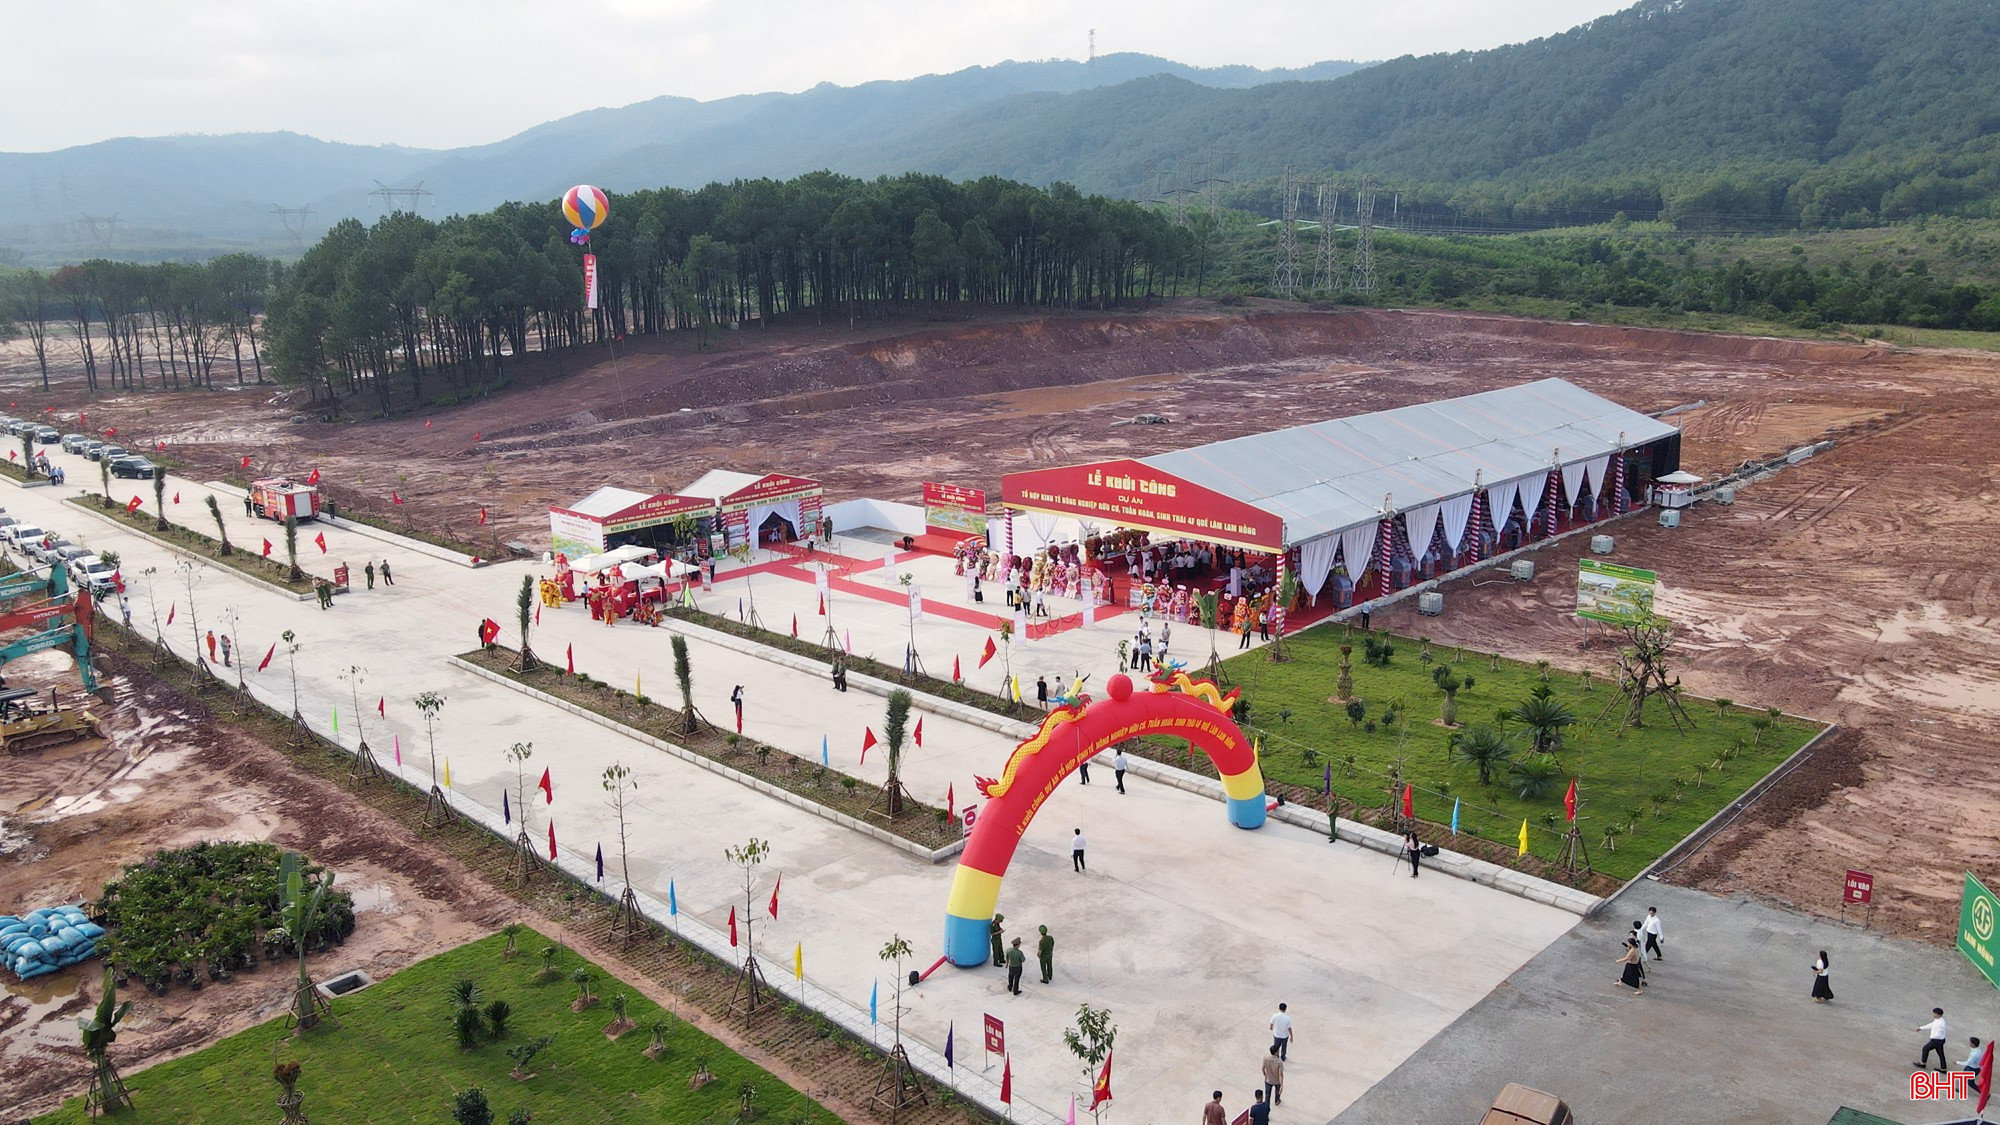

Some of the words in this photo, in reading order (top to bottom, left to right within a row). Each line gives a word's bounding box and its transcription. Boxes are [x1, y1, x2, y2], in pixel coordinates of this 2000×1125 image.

[1088, 469, 1102, 486] LỄ
[1106, 474, 1136, 491] KHỞI
[1139, 480, 1176, 497] CÔNG
[1, 585, 31, 596] KOBELCO
[33, 610, 60, 619] HITACHI
[27, 640, 55, 651] KOBELCO
[1964, 929, 1977, 949] LAM
[1977, 942, 1994, 967] HỒNG
